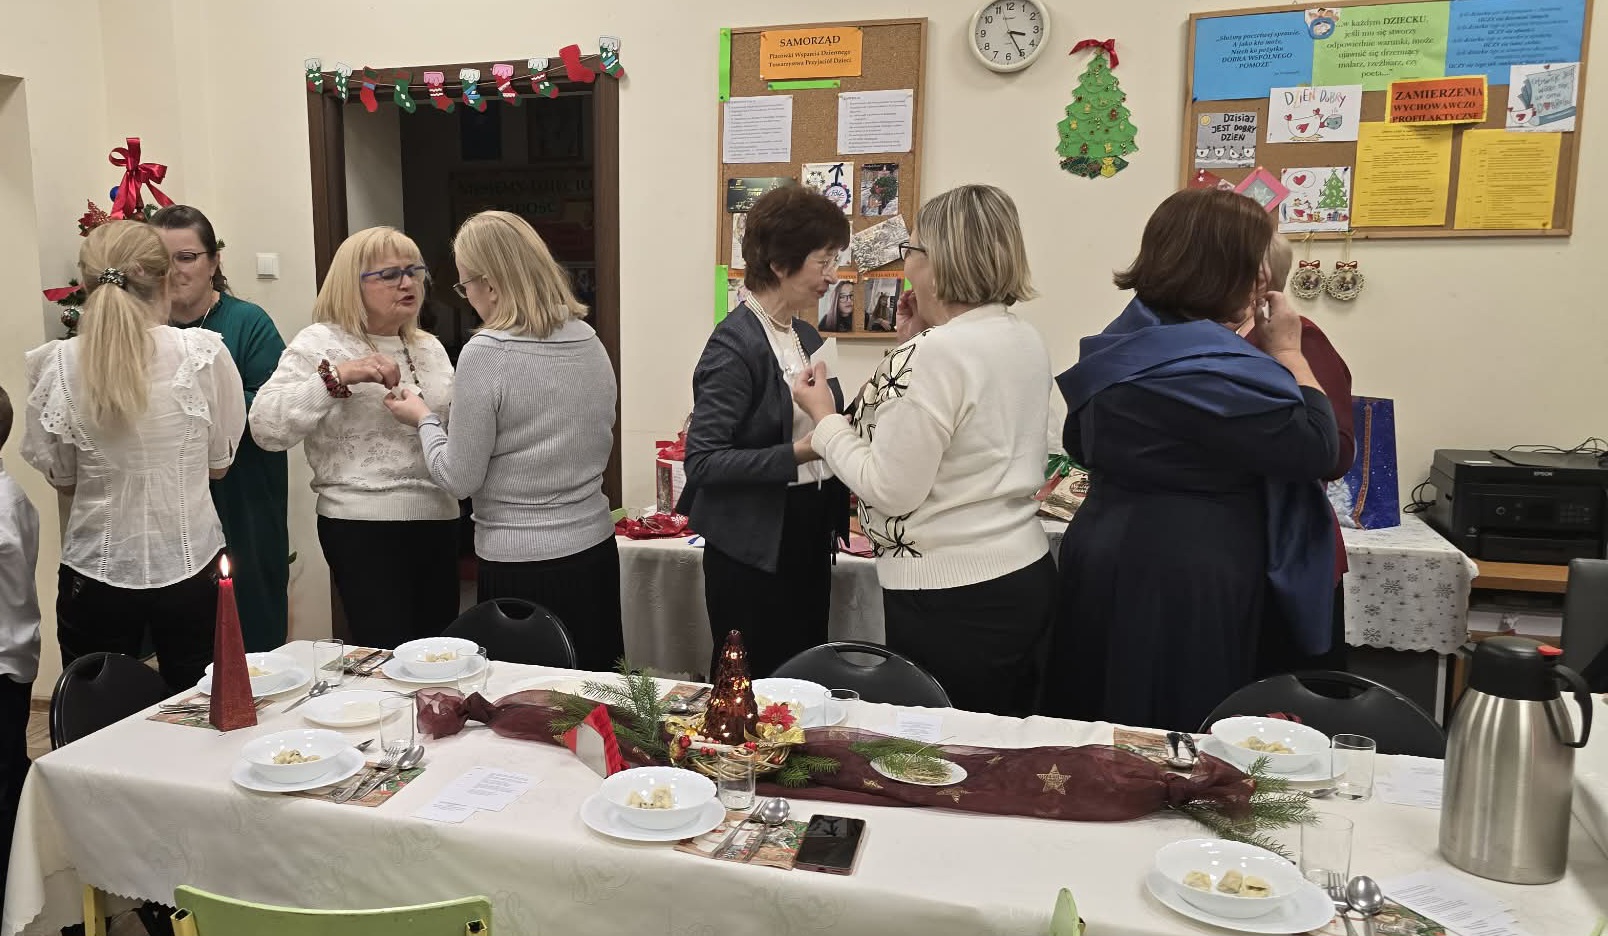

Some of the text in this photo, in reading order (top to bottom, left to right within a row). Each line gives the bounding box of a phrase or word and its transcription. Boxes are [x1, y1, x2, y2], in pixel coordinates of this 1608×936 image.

[1006, 3, 1015, 11] 12
[1029, 12, 1036, 21] 2
[980, 30, 986, 38] 9
[1033, 26, 1039, 34] 3
[780, 35, 841, 47] SAMORZĄD
[1029, 39, 1035, 47] 4
[984, 43, 990, 51] 8
[993, 51, 999, 59] 7
[1005, 53, 1012, 61] 6
[1248, 52, 1293, 61] WSPÓLNEGO
[1395, 87, 1483, 101] ZAMIERZENIA
[1391, 112, 1479, 123] PROFILAKTYCZNE
[1211, 124, 1257, 134] JEST DOBRY
